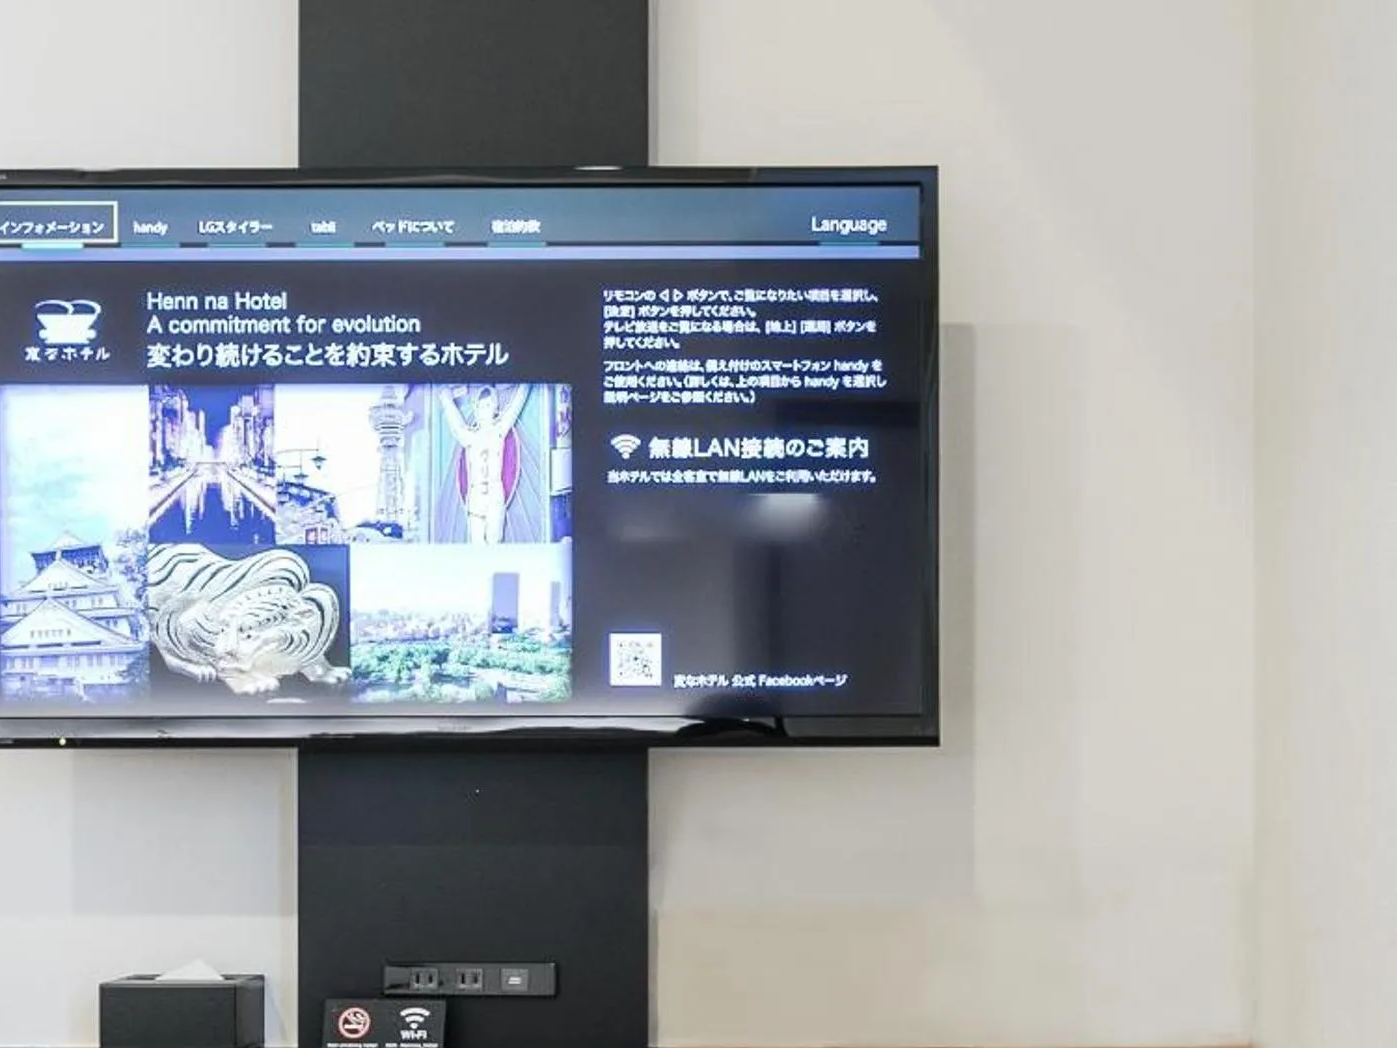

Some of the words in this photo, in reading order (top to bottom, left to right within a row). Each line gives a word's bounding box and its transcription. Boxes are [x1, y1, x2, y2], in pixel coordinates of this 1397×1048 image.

[133, 221, 168, 236] handy
[811, 217, 887, 235] Language
[147, 291, 199, 310] Henn
[204, 295, 229, 310] na
[234, 291, 287, 310] Hotel
[146, 315, 163, 334] A
[168, 314, 292, 334] commitment
[295, 314, 326, 334] for
[331, 314, 421, 334] evolution
[146, 341, 509, 368] 変わり続けることを約束するホテル
[648, 436, 869, 459] 無線LAN接続のご案内
